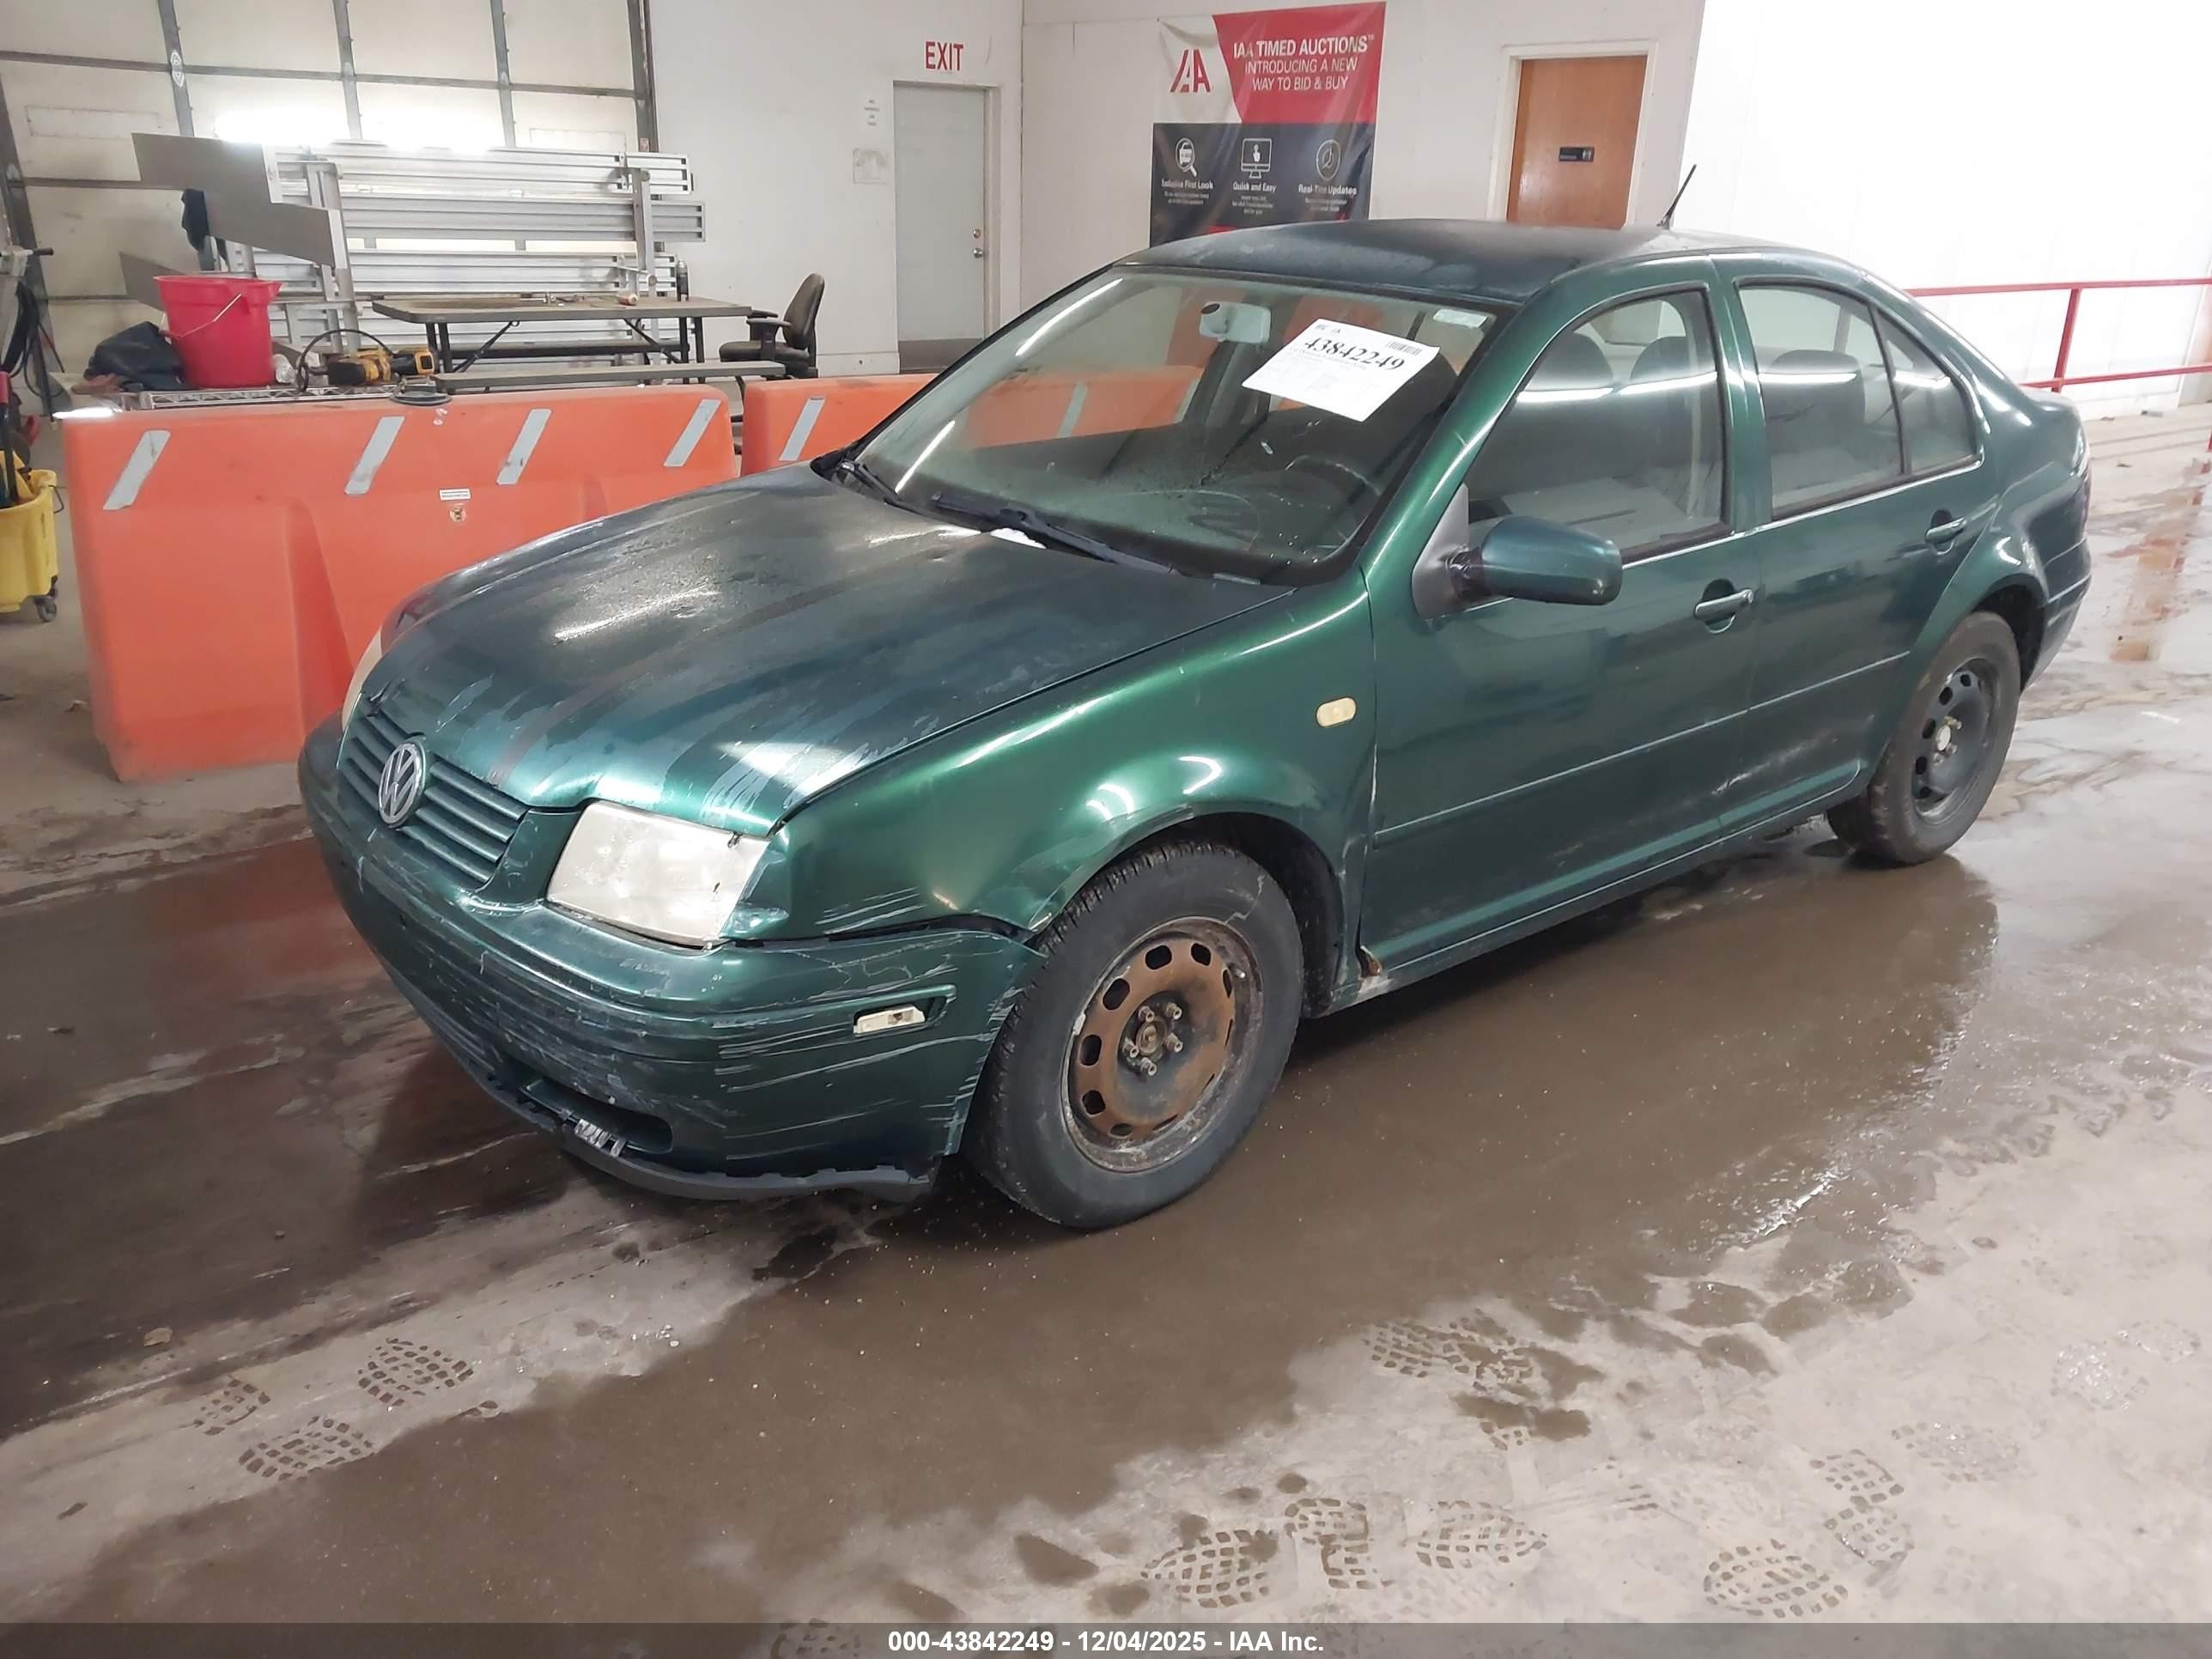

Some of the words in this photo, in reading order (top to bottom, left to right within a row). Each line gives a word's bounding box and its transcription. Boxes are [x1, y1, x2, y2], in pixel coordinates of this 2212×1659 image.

[925, 41, 963, 71] EXIT
[1256, 40, 1296, 58] TIMED
[1245, 58, 1317, 75] INTRODUCING
[1320, 58, 1328, 72] A
[1331, 57, 1358, 72] NEW
[1252, 77, 1275, 91] WAY
[1277, 76, 1291, 91] TO
[1293, 76, 1312, 91] BID
[1314, 76, 1322, 90] &
[1325, 75, 1348, 90] BUY
[1197, 180, 1214, 190] Look
[1232, 181, 1249, 191] Quick
[1250, 182, 1261, 191] and
[1262, 182, 1277, 193] Easy
[1328, 185, 1358, 196] Updates
[1304, 337, 1405, 370] 43842249
